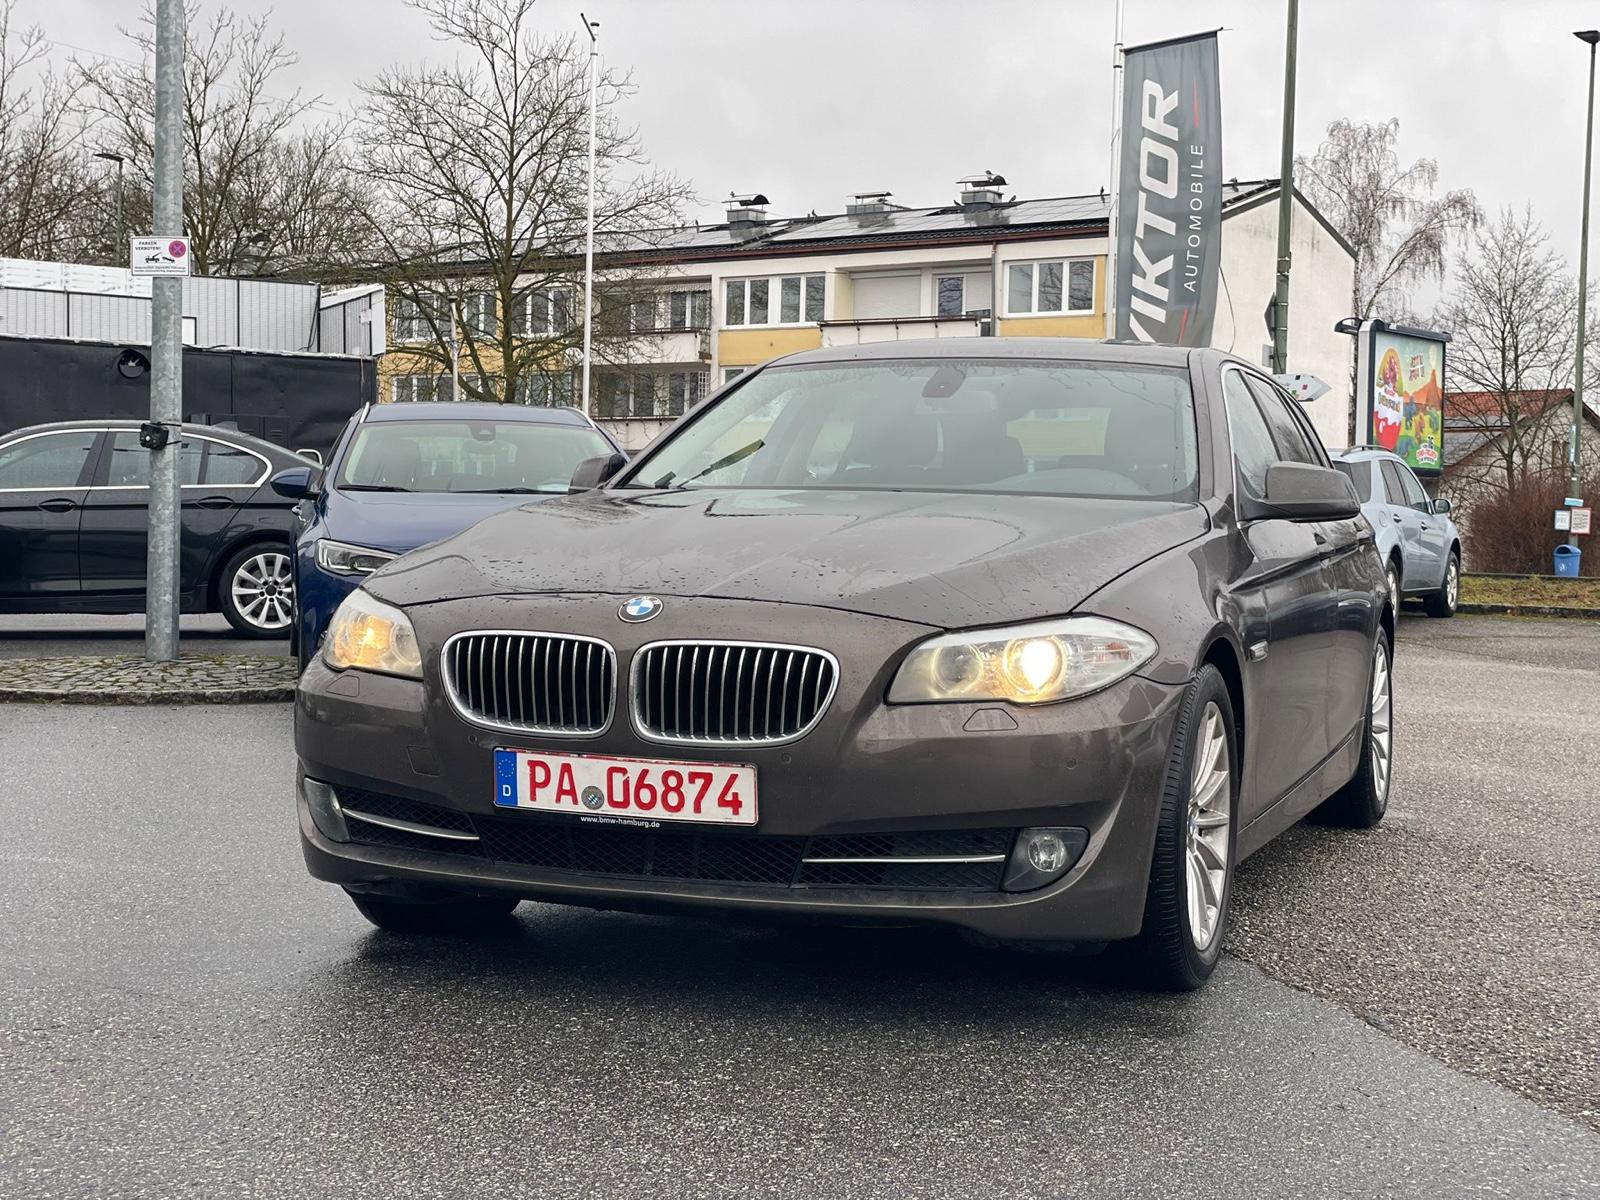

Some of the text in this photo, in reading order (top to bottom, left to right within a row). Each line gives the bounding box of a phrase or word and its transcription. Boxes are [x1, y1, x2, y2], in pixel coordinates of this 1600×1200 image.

[1183, 144, 1204, 292] AUTOMOBILE
[502, 784, 512, 796] D
[526, 759, 744, 816] PA 06874
[580, 816, 660, 829] www.bmw-hamburg.de
